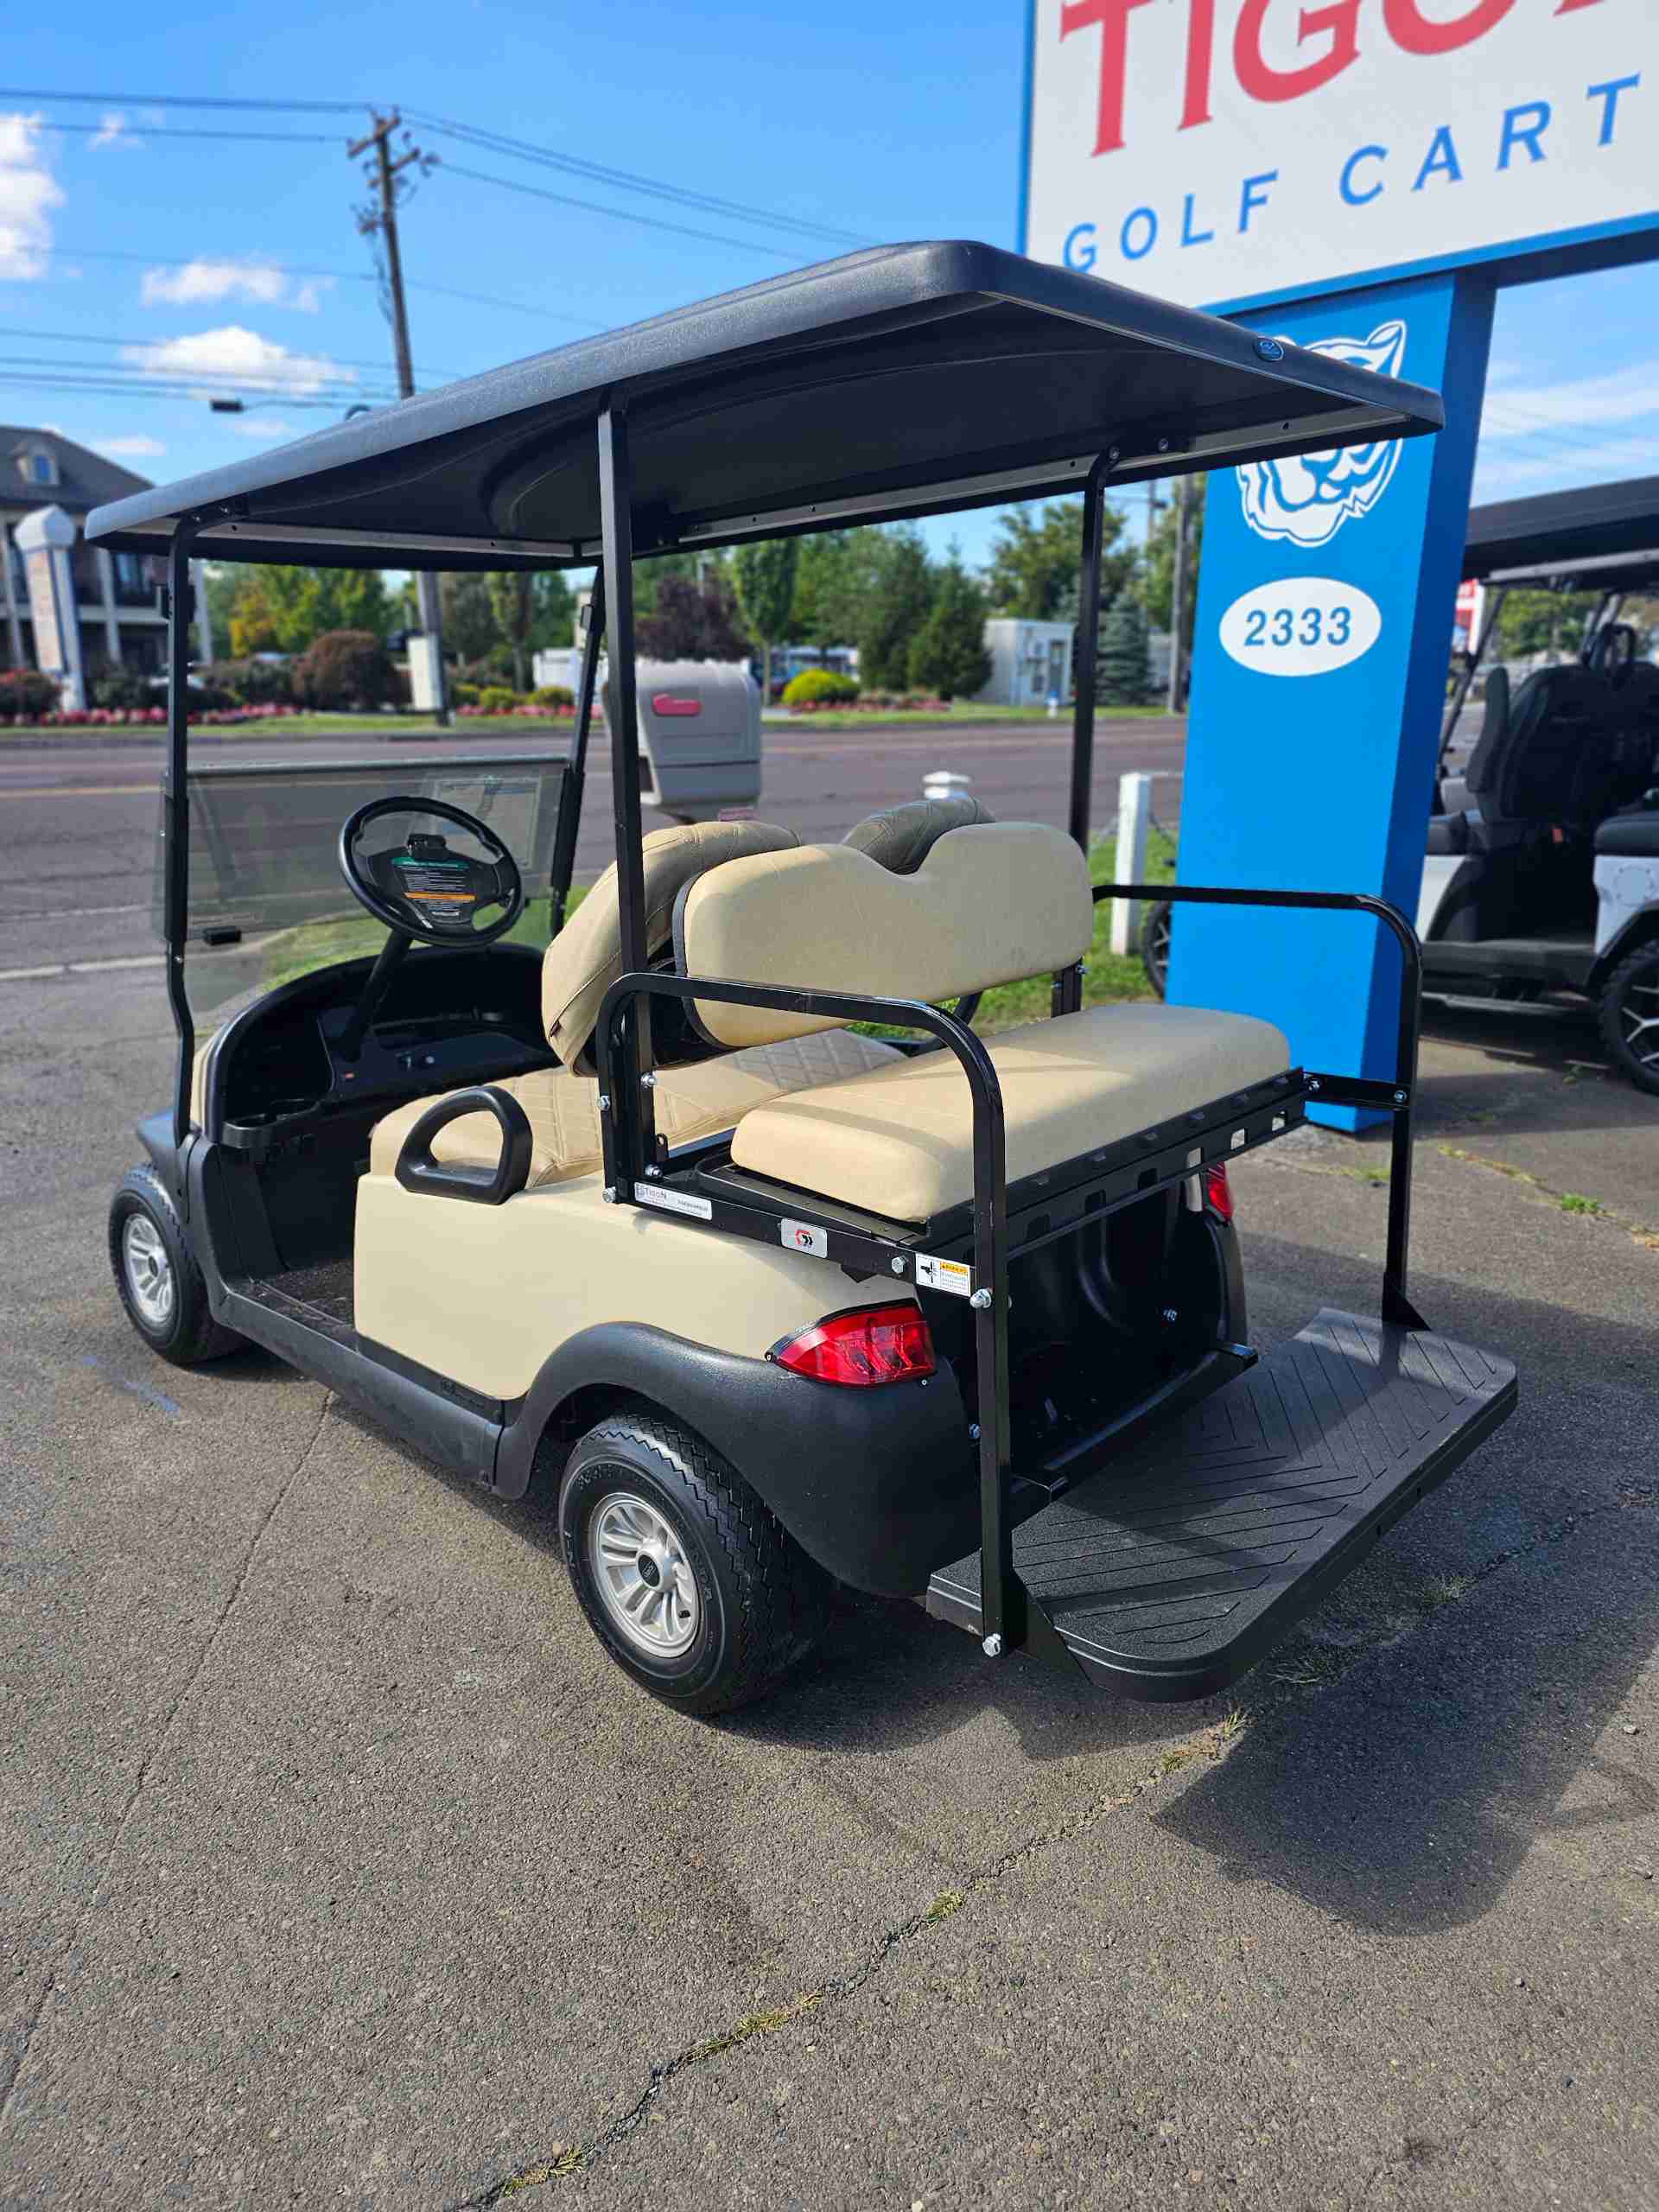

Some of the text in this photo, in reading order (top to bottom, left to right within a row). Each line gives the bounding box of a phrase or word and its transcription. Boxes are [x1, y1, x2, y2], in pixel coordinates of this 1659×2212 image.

[1059, 0, 1605, 157] TIG
[1062, 72, 1642, 274] GOLF CART
[1243, 607, 1353, 648] 2333
